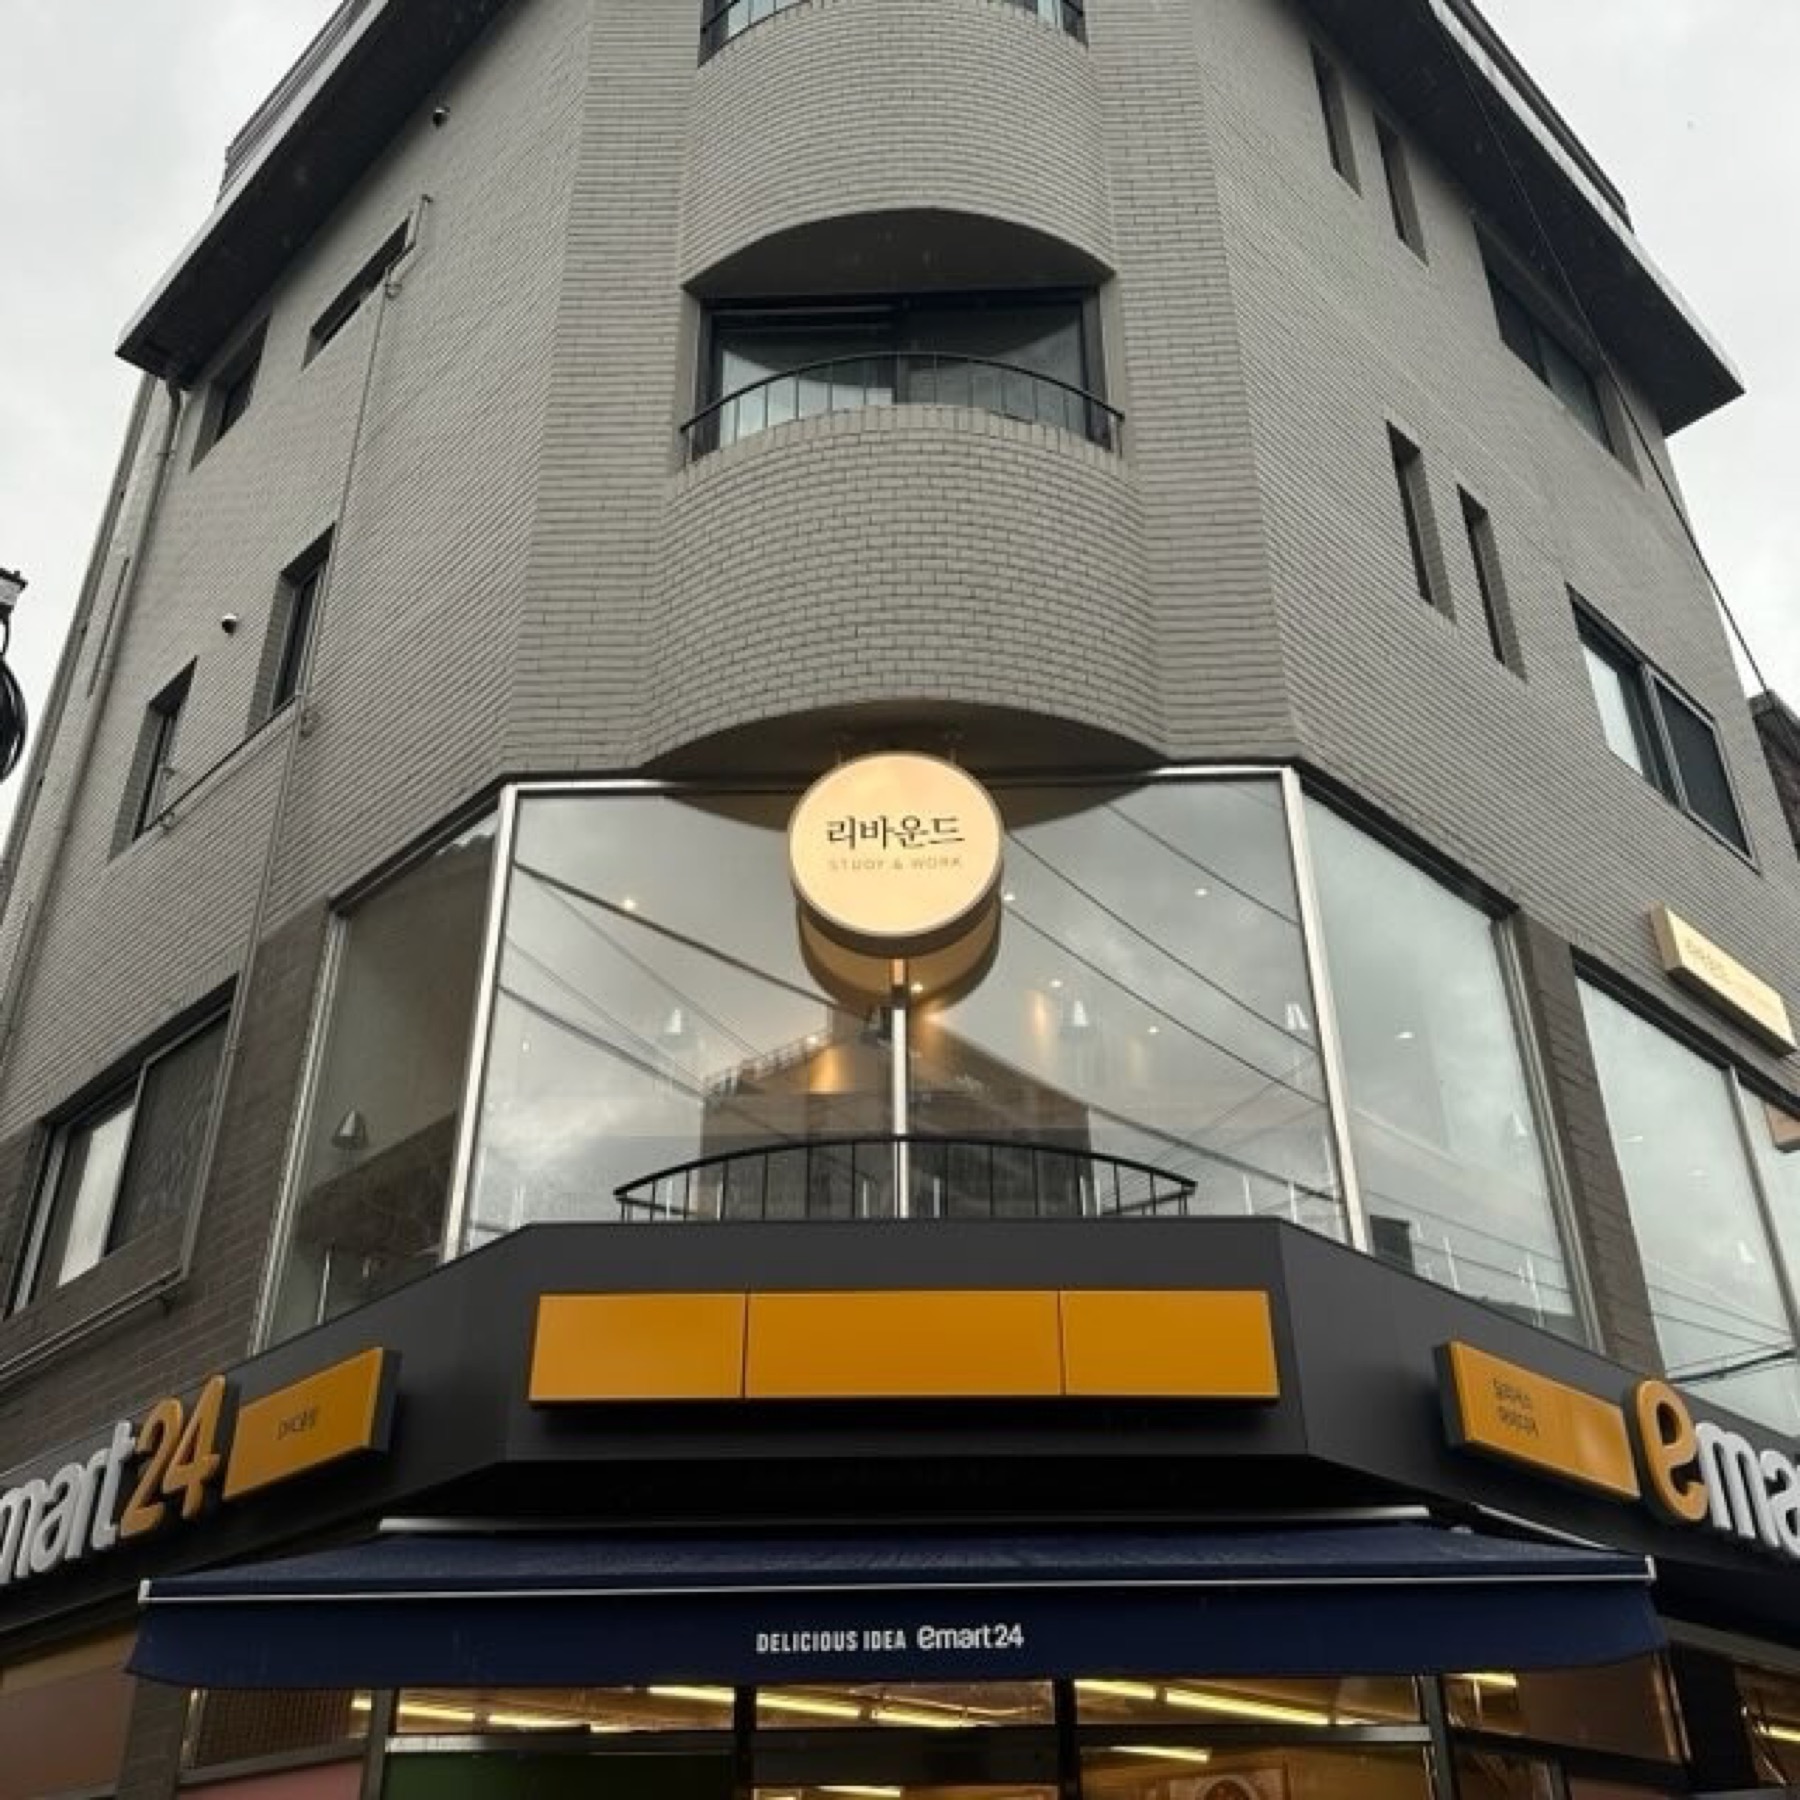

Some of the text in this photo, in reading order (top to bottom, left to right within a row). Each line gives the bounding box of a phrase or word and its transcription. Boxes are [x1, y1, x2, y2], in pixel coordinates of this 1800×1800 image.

[826, 815, 966, 850] 리바운드
[829, 858, 885, 871] STUDY
[756, 1623, 1025, 1654] DELICIOUS IDEA emart24
